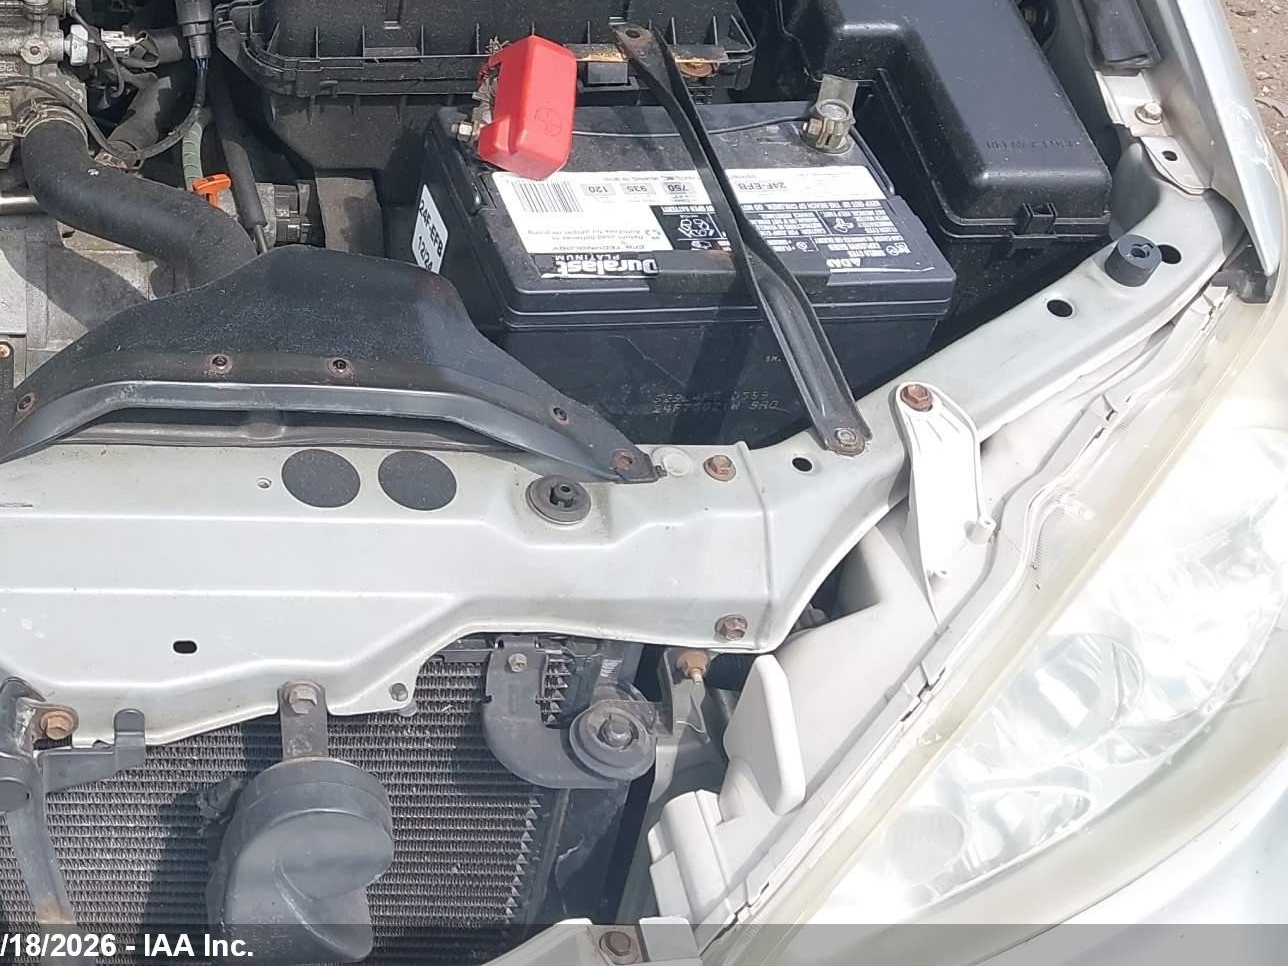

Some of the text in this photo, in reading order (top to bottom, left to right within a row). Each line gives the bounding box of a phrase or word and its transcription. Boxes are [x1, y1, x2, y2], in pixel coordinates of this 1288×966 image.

[588, 185, 609, 194] 120
[627, 184, 649, 192] 935
[667, 183, 689, 192] 750
[738, 181, 787, 191] 24F-EFB
[418, 199, 444, 258] 24F-EFB
[555, 253, 621, 261] PLATINUM
[555, 258, 659, 276] Duralast
